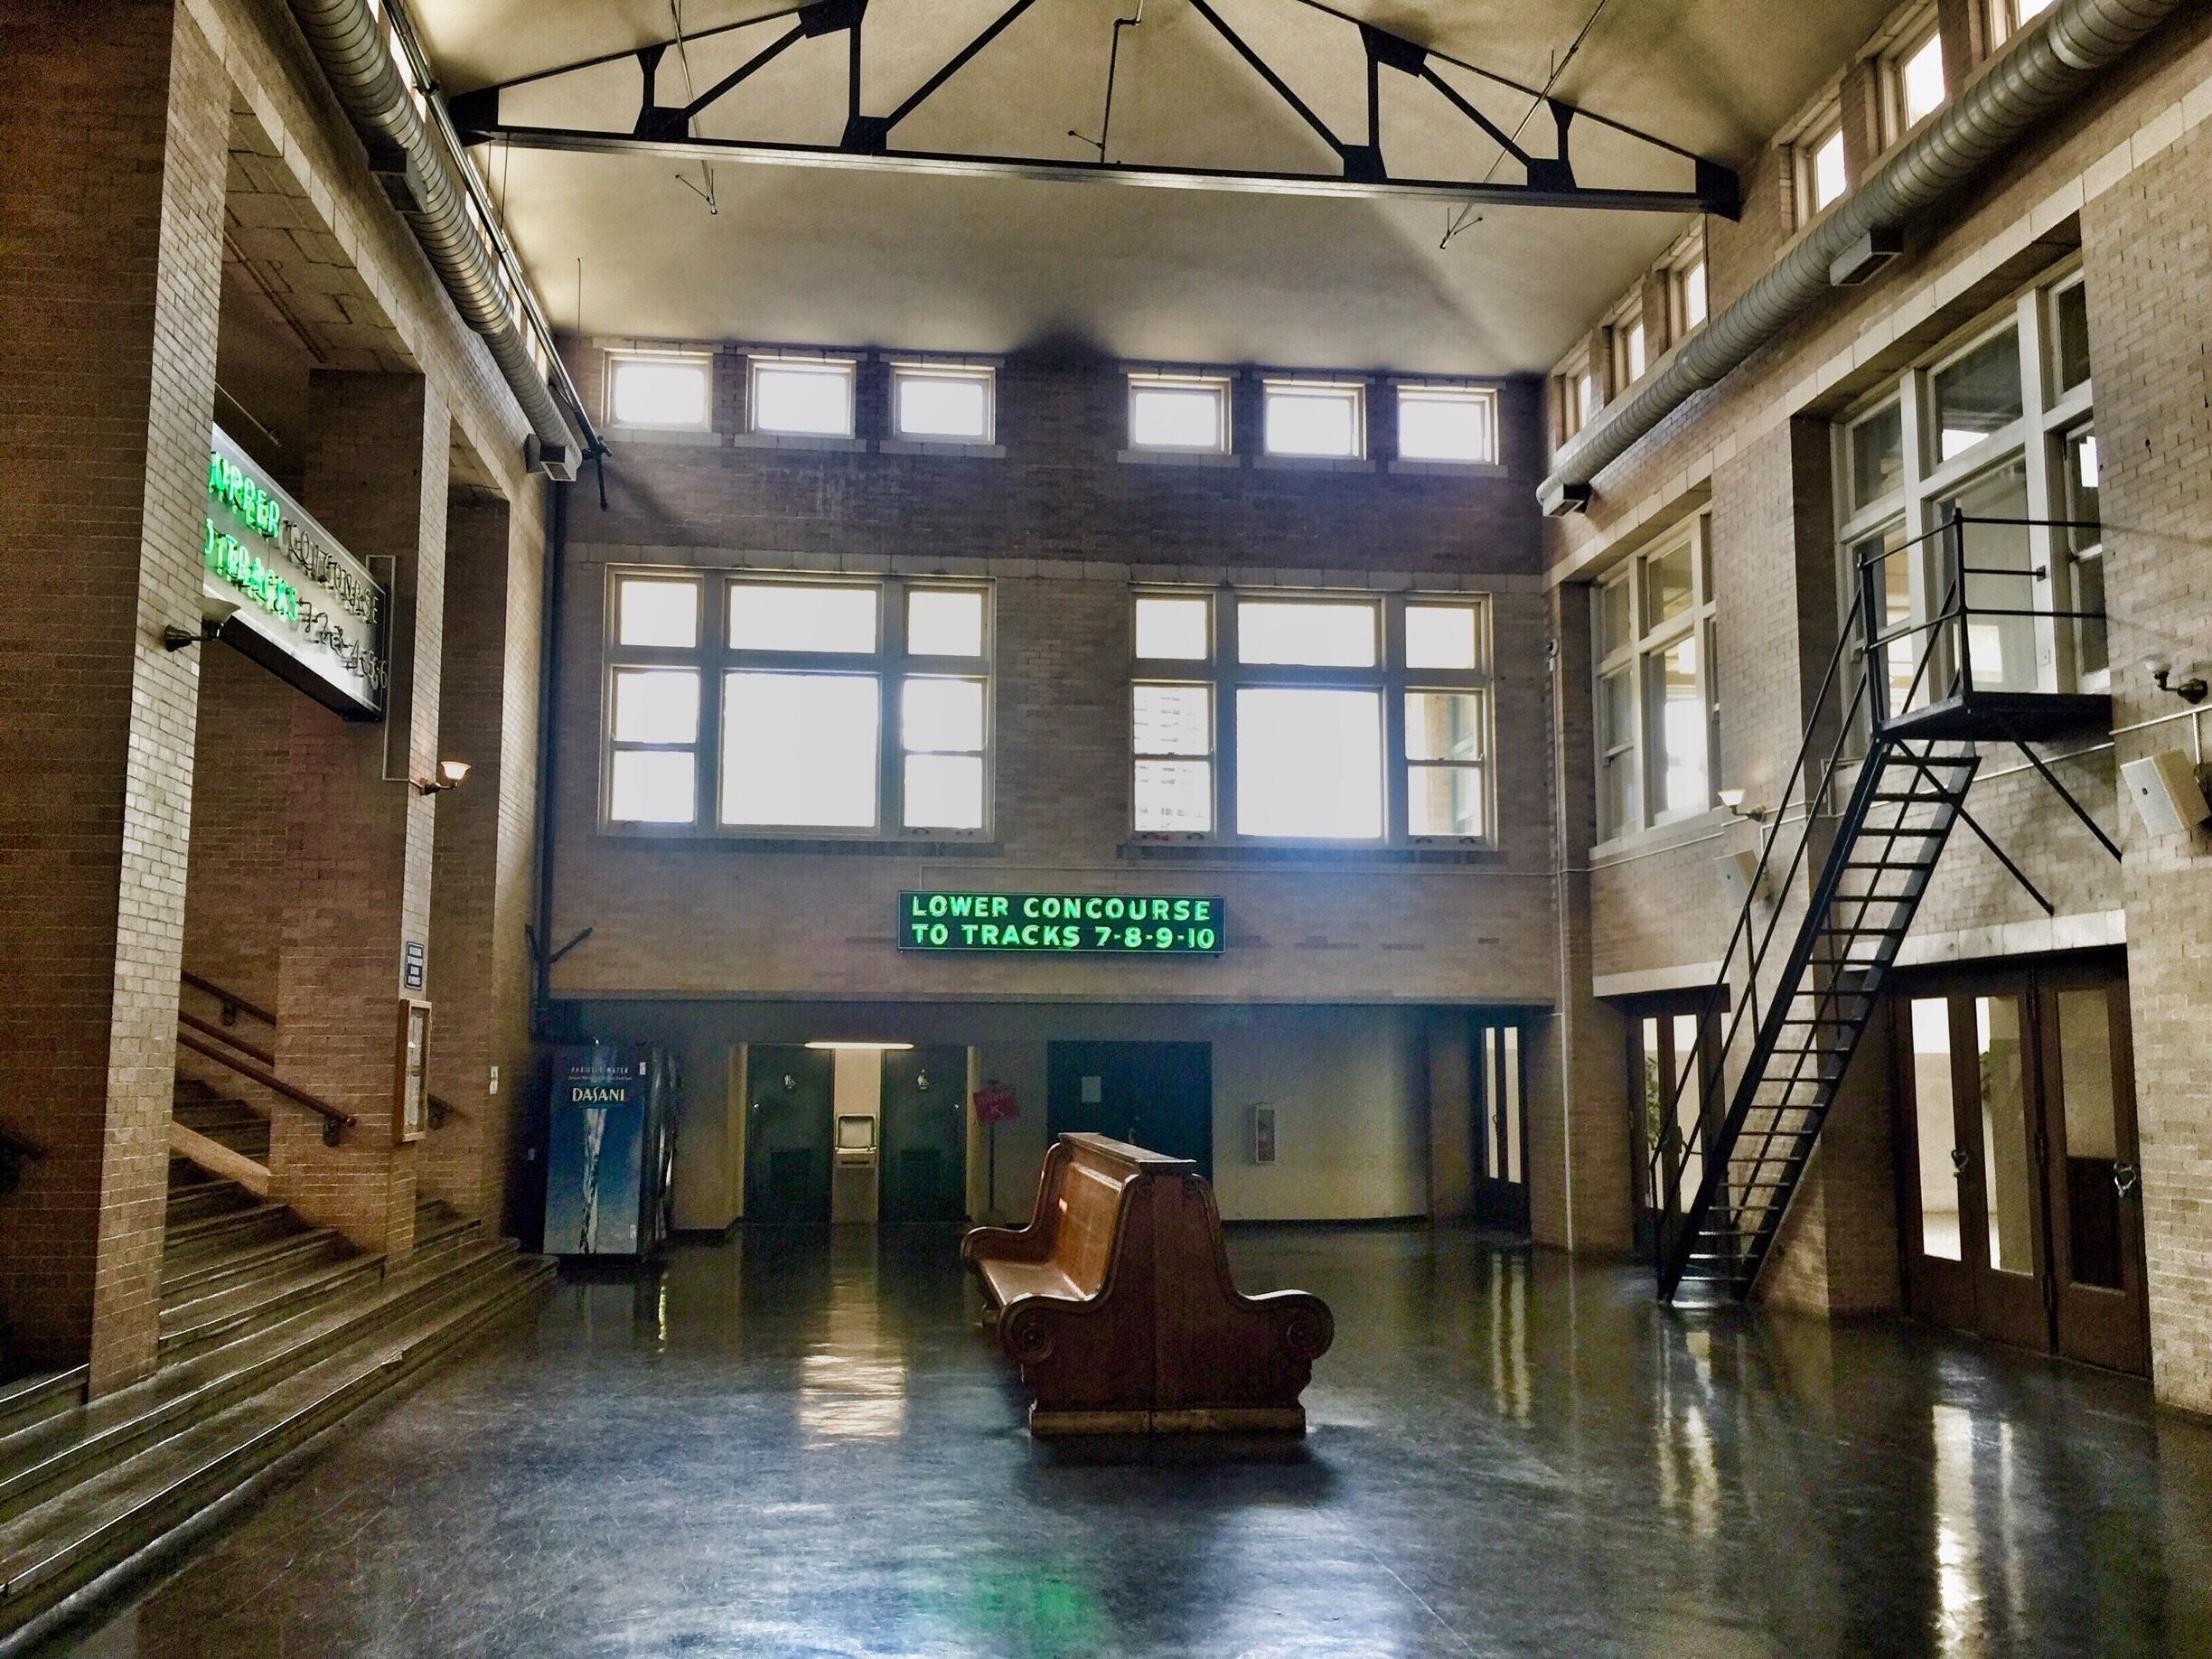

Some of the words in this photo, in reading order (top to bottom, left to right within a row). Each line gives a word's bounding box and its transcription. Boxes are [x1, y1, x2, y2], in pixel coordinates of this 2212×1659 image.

[911, 895, 1009, 917] LOWER
[1023, 897, 1211, 922] CONCOURSE
[911, 923, 949, 945] TO
[961, 923, 1081, 948] TRACKS
[1094, 925, 1215, 949] 7-8-9-10
[572, 1086, 625, 1103] DASANI
